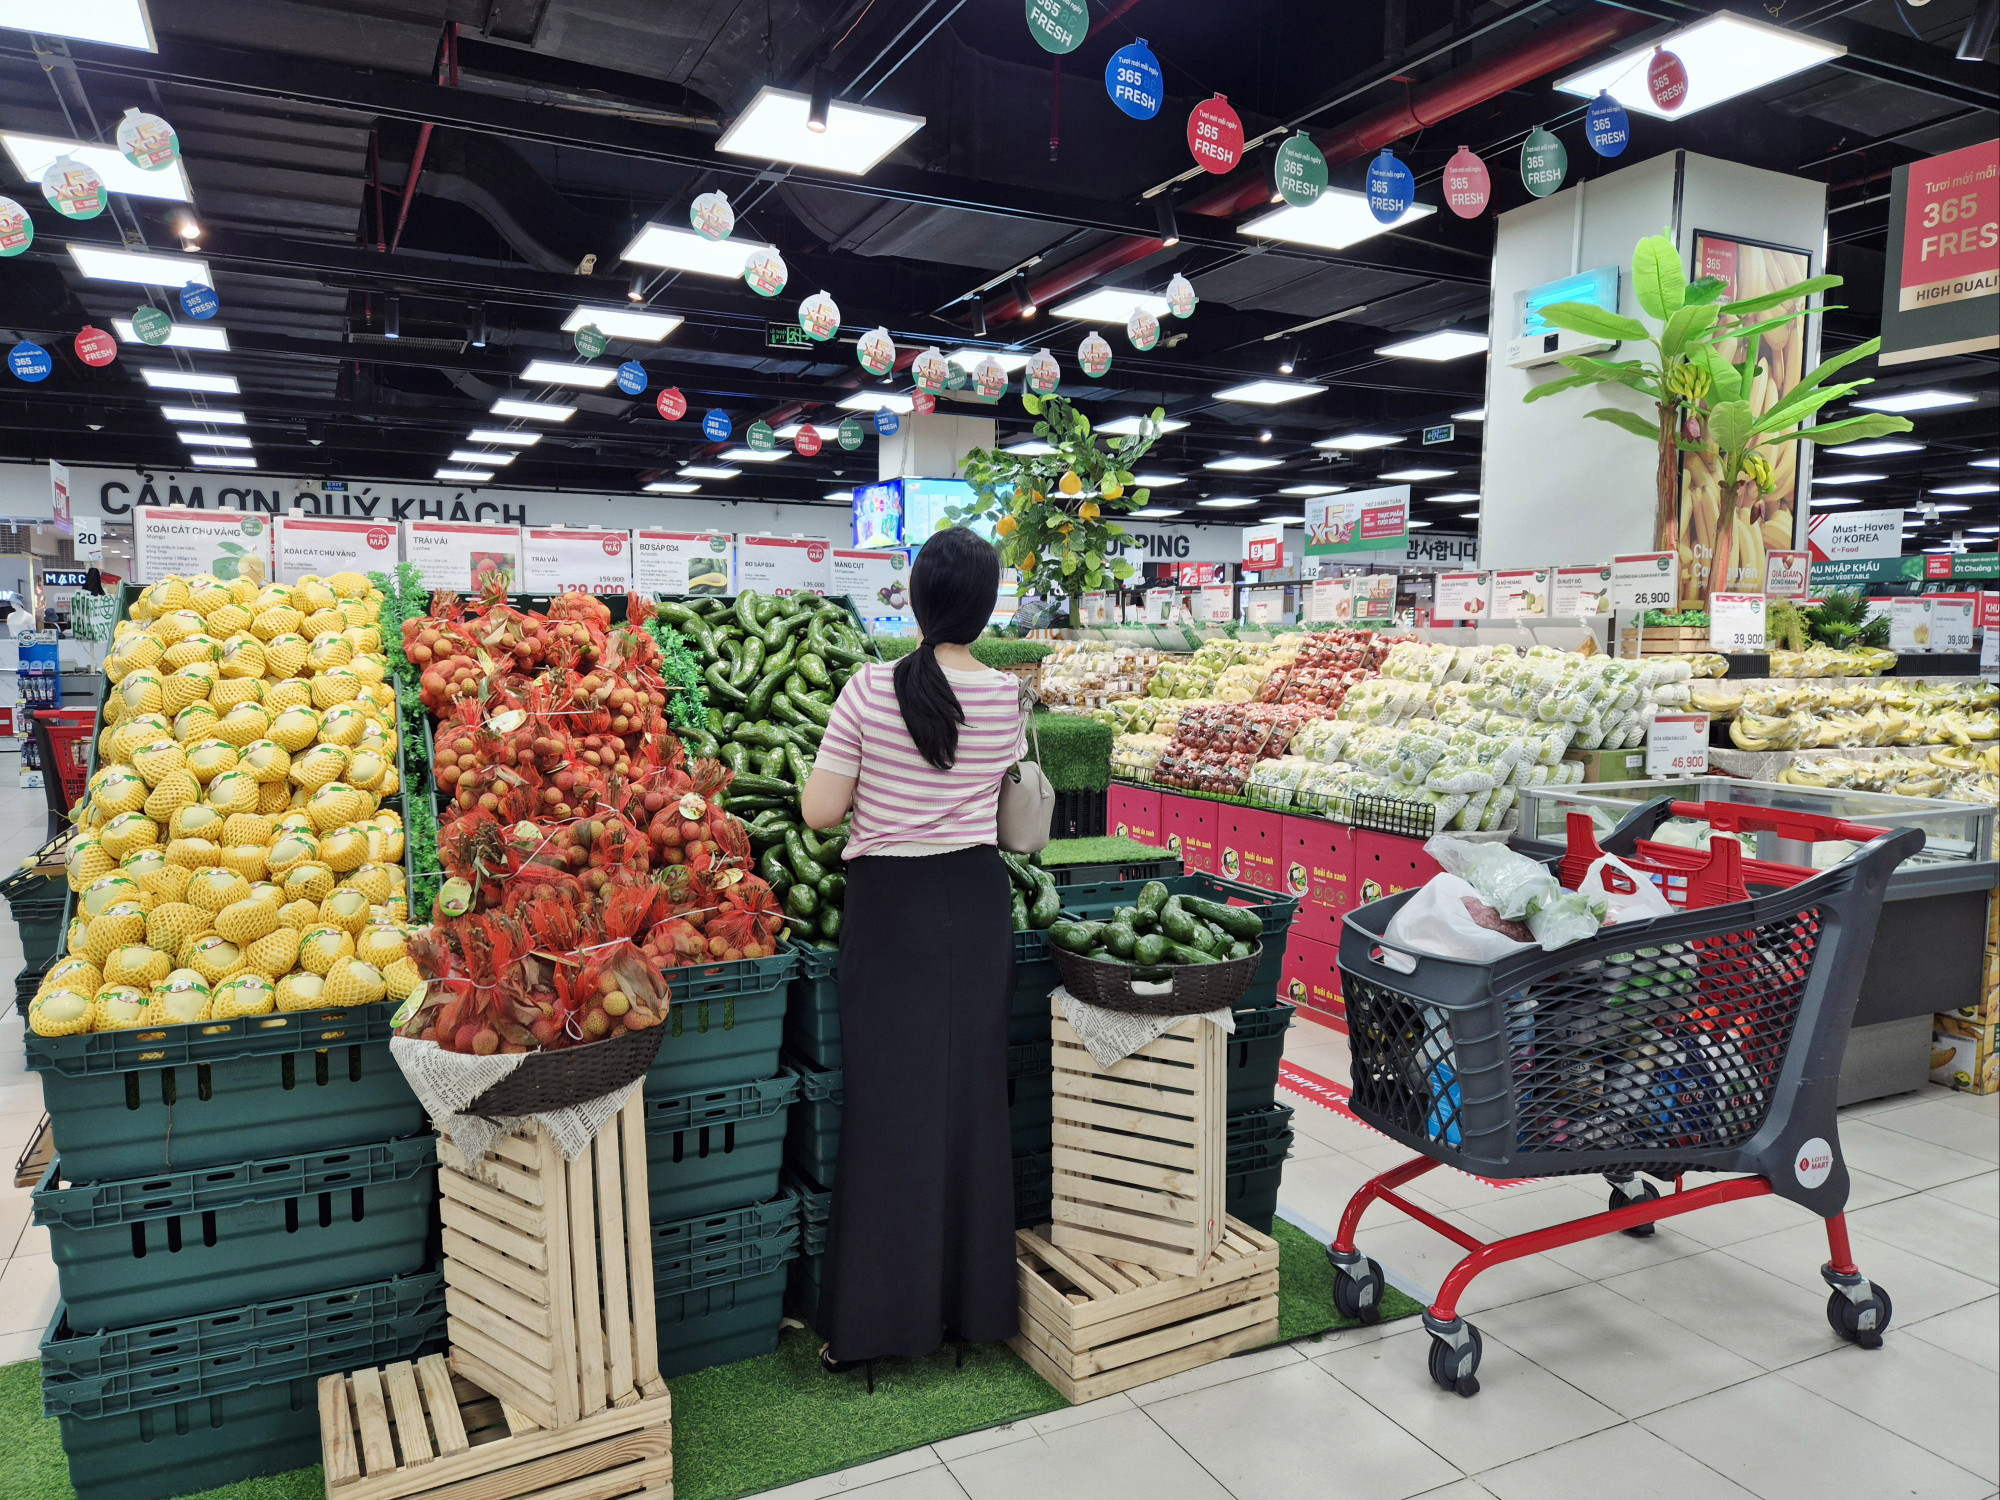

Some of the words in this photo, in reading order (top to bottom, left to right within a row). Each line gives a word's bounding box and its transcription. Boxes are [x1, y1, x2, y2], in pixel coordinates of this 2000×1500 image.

[1030, 6, 1073, 47] FRESH
[1116, 68, 1142, 86] 365
[1653, 74, 1669, 91] 365
[1115, 85, 1156, 112] FRESH
[1656, 82, 1685, 105] FRESH
[1196, 121, 1219, 140] 365
[1593, 118, 1611, 132] 365
[1595, 130, 1626, 147] FRESH
[1194, 138, 1234, 164] FRESH
[1283, 159, 1304, 177] 365
[1527, 156, 1544, 169] 365
[1528, 168, 1561, 185] FRESH
[1925, 177, 1951, 195] Tươi
[1952, 171, 1974, 188] mới
[1975, 164, 1996, 182] mỗi
[1281, 177, 1320, 198] FRESH
[1371, 179, 1388, 194] 365
[1450, 177, 1468, 190] 365
[1371, 196, 1404, 212] FRESH
[1451, 192, 1484, 206] FRESH
[1922, 192, 1978, 228] 365
[1921, 222, 1999, 262] FRES
[1706, 257, 1721, 271] 365
[1916, 284, 1951, 301] HIGH
[186, 296, 202, 307] 365
[190, 301, 217, 315] FRESH
[139, 321, 155, 332] 365
[143, 327, 170, 341] FRESH
[81, 342, 98, 353] 365
[578, 341, 601, 354] FRESH
[85, 348, 114, 362] FRESH
[15, 358, 31, 366] 365
[17, 365, 47, 375] FRESH
[621, 371, 634, 380] 365
[619, 378, 641, 391] FRESH
[662, 397, 674, 407] 365
[660, 404, 681, 417] FRESH
[706, 428, 727, 437] FRESH
[879, 422, 898, 432] FRESH
[751, 439, 771, 449] FRESH
[798, 443, 818, 451] FRESH
[841, 437, 861, 445] FRESH
[100, 474, 206, 515] CẢM
[217, 487, 279, 512] ƠN
[393, 492, 526, 525] KHÁCH
[146, 524, 170, 534] XOÀI
[171, 524, 190, 534] CÁT
[192, 527, 213, 536] CHU
[213, 526, 241, 537] VÀNG
[78, 533, 97, 545] 20
[1831, 535, 1843, 544] Of
[1844, 533, 1880, 544] KOREA
[303, 548, 318, 556] CÁT
[336, 549, 357, 558] VÀNG
[651, 543, 666, 551] SÁP
[666, 544, 679, 552] 034
[1253, 546, 1259, 556] 9
[1406, 539, 1478, 561] 감사합니다
[834, 561, 852, 569] MĂNG
[853, 562, 865, 570] CỤT
[1308, 567, 1317, 576] 12
[1810, 565, 1823, 574] AU
[1824, 562, 1852, 575] NHẬP
[1852, 560, 1880, 573] KHẨU
[557, 584, 625, 594] 129000
[1635, 592, 1670, 605] 26,900
[1212, 610, 1230, 619] 89,000
[1733, 633, 1763, 645] 39,900
[1947, 635, 1970, 646] 39,900
[1671, 755, 1704, 769] 46,900
[1334, 873, 1347, 882] xanh
[1334, 994, 1345, 1004] xan
[1811, 1155, 1829, 1163] LOTTE
[1811, 1161, 1829, 1170] MART
